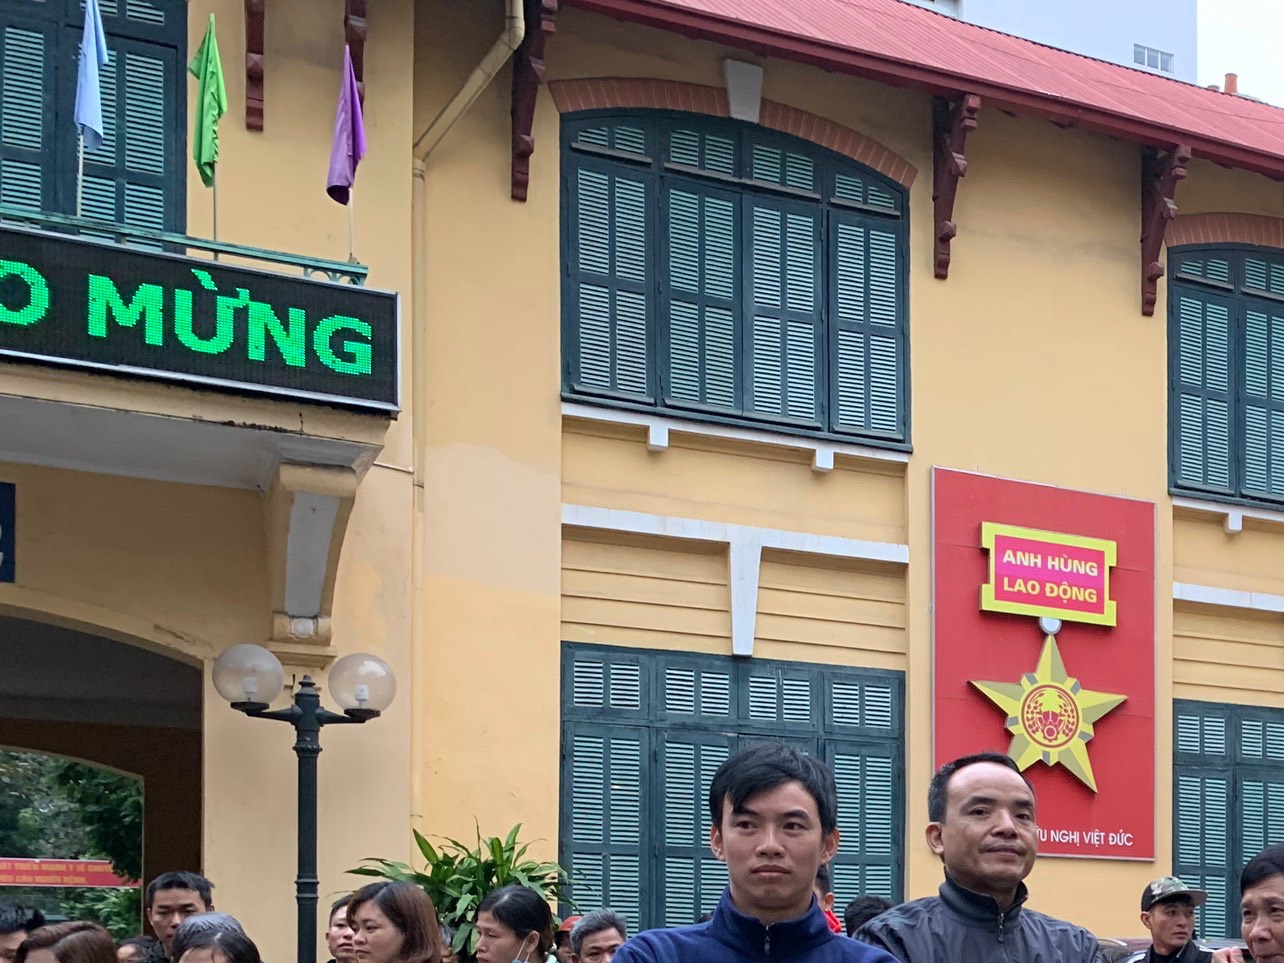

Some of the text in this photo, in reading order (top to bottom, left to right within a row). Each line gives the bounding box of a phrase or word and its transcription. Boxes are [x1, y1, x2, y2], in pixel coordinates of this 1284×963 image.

[88, 268, 372, 375] MỪNG
[1002, 549, 1098, 576] ANH HÙNG
[1003, 576, 1097, 604] LAO ĐỘNG
[1050, 829, 1080, 847] NGHỊ
[1083, 828, 1106, 848] VIỆT
[1108, 829, 1134, 846] ĐỨC
